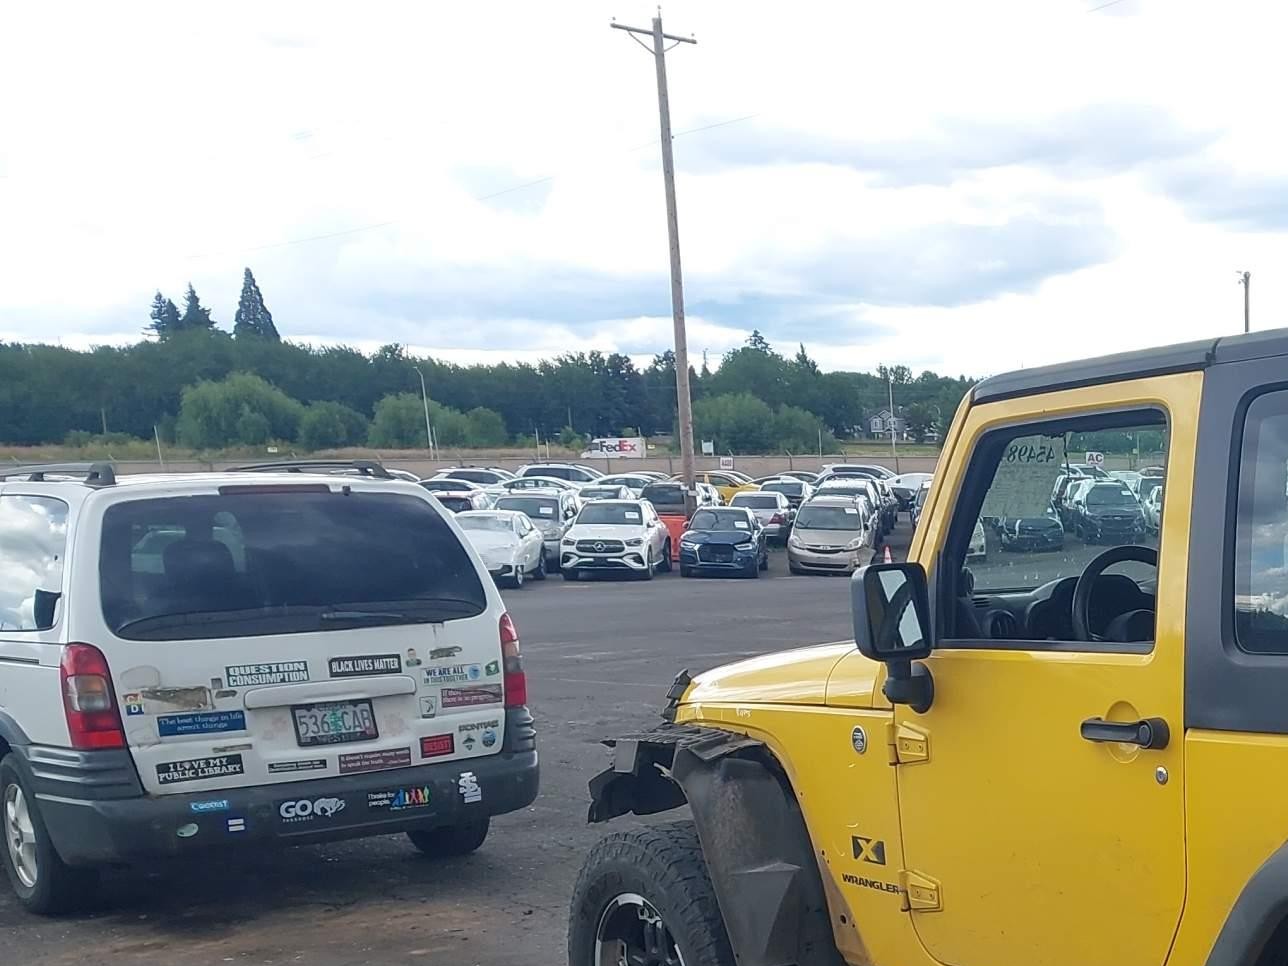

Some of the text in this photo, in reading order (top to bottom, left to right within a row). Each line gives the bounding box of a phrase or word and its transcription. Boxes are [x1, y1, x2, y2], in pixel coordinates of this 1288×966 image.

[600, 440, 637, 453] FedEx
[228, 662, 305, 676] QUESTION
[331, 658, 399, 673] BLACK LIVES MATTER
[425, 666, 464, 677] WE ARE ALL
[229, 671, 308, 686] CONSUMPTION
[298, 709, 372, 737] 536 CAB
[458, 719, 499, 732] PONTIAC
[209, 757, 228, 766] MY
[158, 764, 241, 782] PUBLIC LIBRARY
[280, 799, 313, 818] GO
[842, 873, 900, 895] WRANGLER
